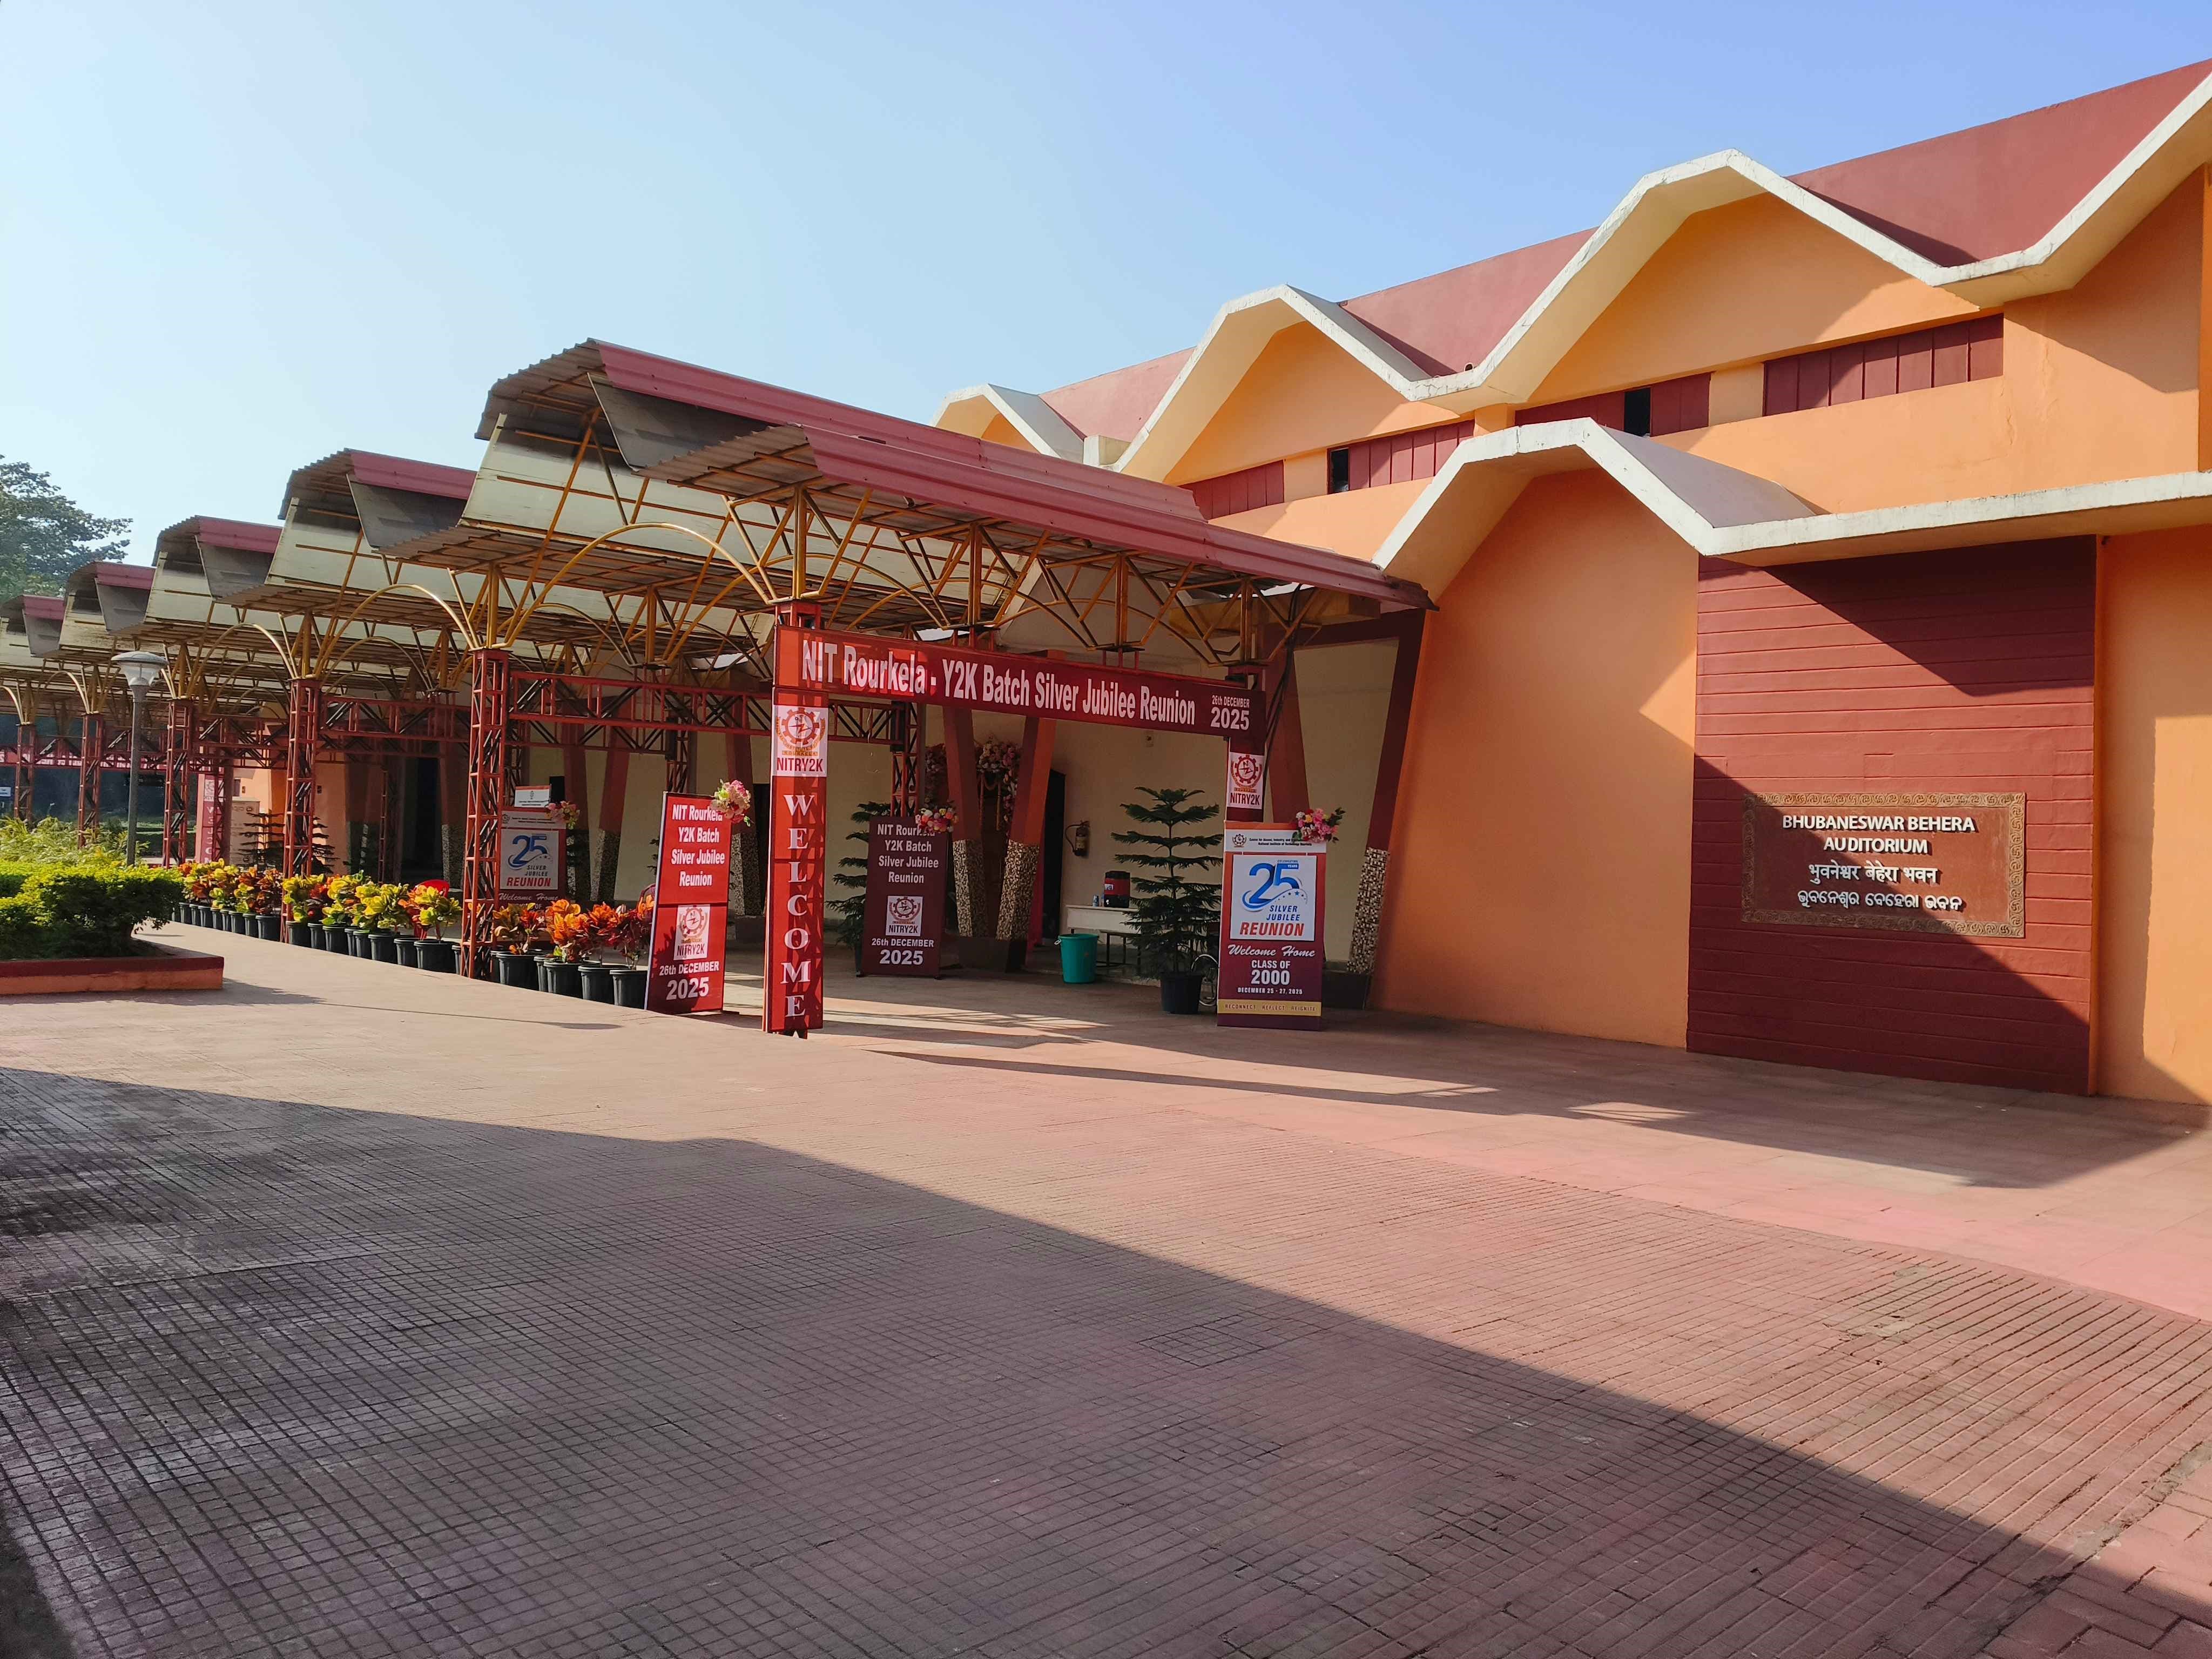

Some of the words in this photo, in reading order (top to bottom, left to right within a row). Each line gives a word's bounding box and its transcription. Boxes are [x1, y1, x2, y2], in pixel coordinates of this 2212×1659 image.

[802, 640, 838, 683] NIT
[844, 645, 925, 694] Rourkela
[942, 659, 978, 700] Y2K
[983, 664, 1029, 706] Batch
[1035, 672, 1079, 711] Silver
[1082, 678, 1136, 719] Jubilee
[1140, 685, 1195, 725] Reunion
[1212, 695, 1223, 705] 26th
[1224, 697, 1250, 709] DECEMBER
[1210, 706, 1249, 730] 2025
[777, 758, 823, 772] NITRY2K
[1230, 793, 1260, 805] NITRY2K
[672, 804, 688, 820] NIT
[878, 824, 894, 835] NIT
[1783, 814, 1905, 832] BHUBANESWAR
[1907, 816, 1975, 832] BEHERA
[678, 827, 696, 842] Y2K
[697, 827, 719, 843] Batch
[512, 834, 548, 865] 25
[885, 840, 903, 851] Y2K
[906, 840, 932, 852] Batch
[1824, 838, 1928, 854] AUDITORIUM
[671, 849, 695, 865] Silver
[696, 849, 725, 865] Jubilee
[879, 855, 904, 868] Silver
[906, 856, 939, 868] Jubilee
[679, 871, 712, 886] Reunion
[888, 872, 924, 884] Reunion
[1808, 859, 1861, 885] भुवनेश्वर
[1864, 860, 1899, 883] बेहेरा
[1903, 866, 1938, 884] भवन
[507, 877, 551, 887] REUNION
[1249, 862, 1300, 903] 25
[498, 893, 531, 901] Welcome
[1865, 892, 1918, 908] ବେହେରା
[1924, 895, 1963, 911] ଭବନ
[780, 794, 815, 1018] WELCOME
[889, 925, 918, 934] NITRY2K
[1240, 922, 1304, 936] REUNION
[677, 944, 705, 956] NITRY2K
[872, 938, 889, 946] 26th
[891, 939, 934, 947] DECEMBER
[879, 949, 923, 965] 2025
[1228, 945, 1277, 956] Welcome
[1282, 945, 1316, 957] Home
[659, 965, 676, 976] 26th
[678, 961, 719, 974] DECEMBER
[1251, 960, 1277, 969] CLASS
[1280, 961, 1290, 969] OF
[1251, 969, 1290, 985] 2000
[666, 977, 709, 1000] 2025
